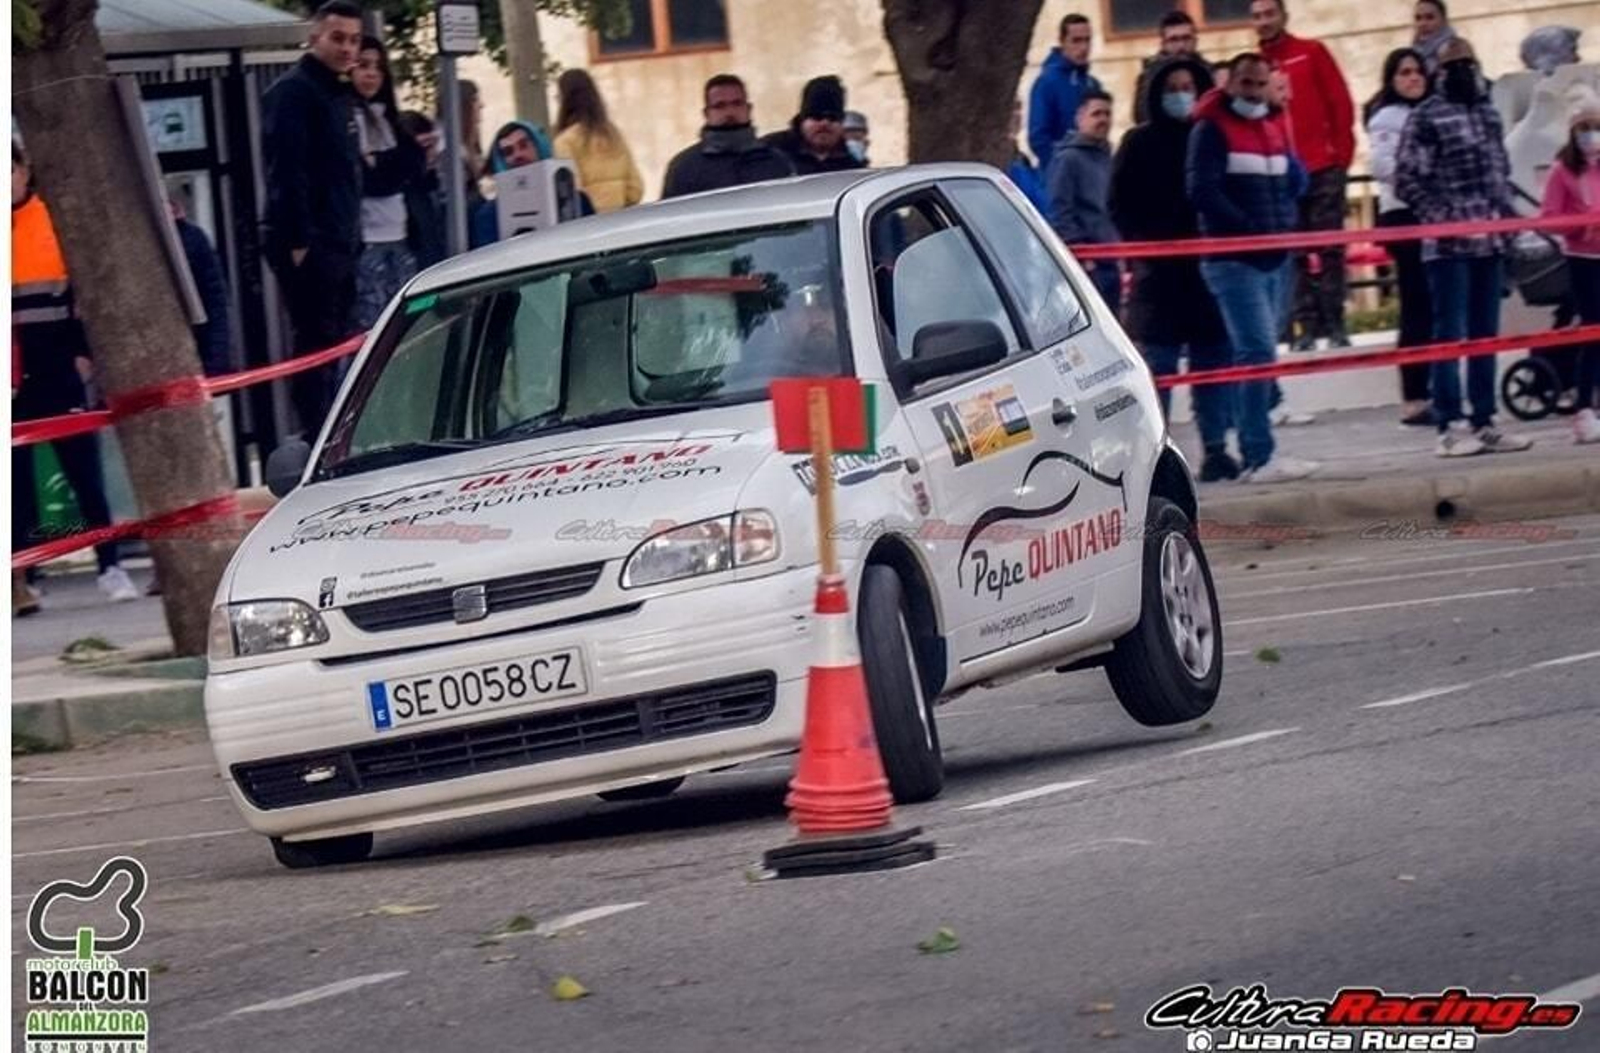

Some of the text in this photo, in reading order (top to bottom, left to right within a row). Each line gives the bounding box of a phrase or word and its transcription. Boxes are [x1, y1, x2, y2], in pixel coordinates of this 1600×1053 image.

[942, 410, 966, 456] 1
[458, 443, 713, 493] QUINTANO
[268, 465, 722, 554] www.pepequintano.com
[970, 508, 1122, 602] Pepe QUINTANO
[376, 653, 577, 721] E SE0058CZ
